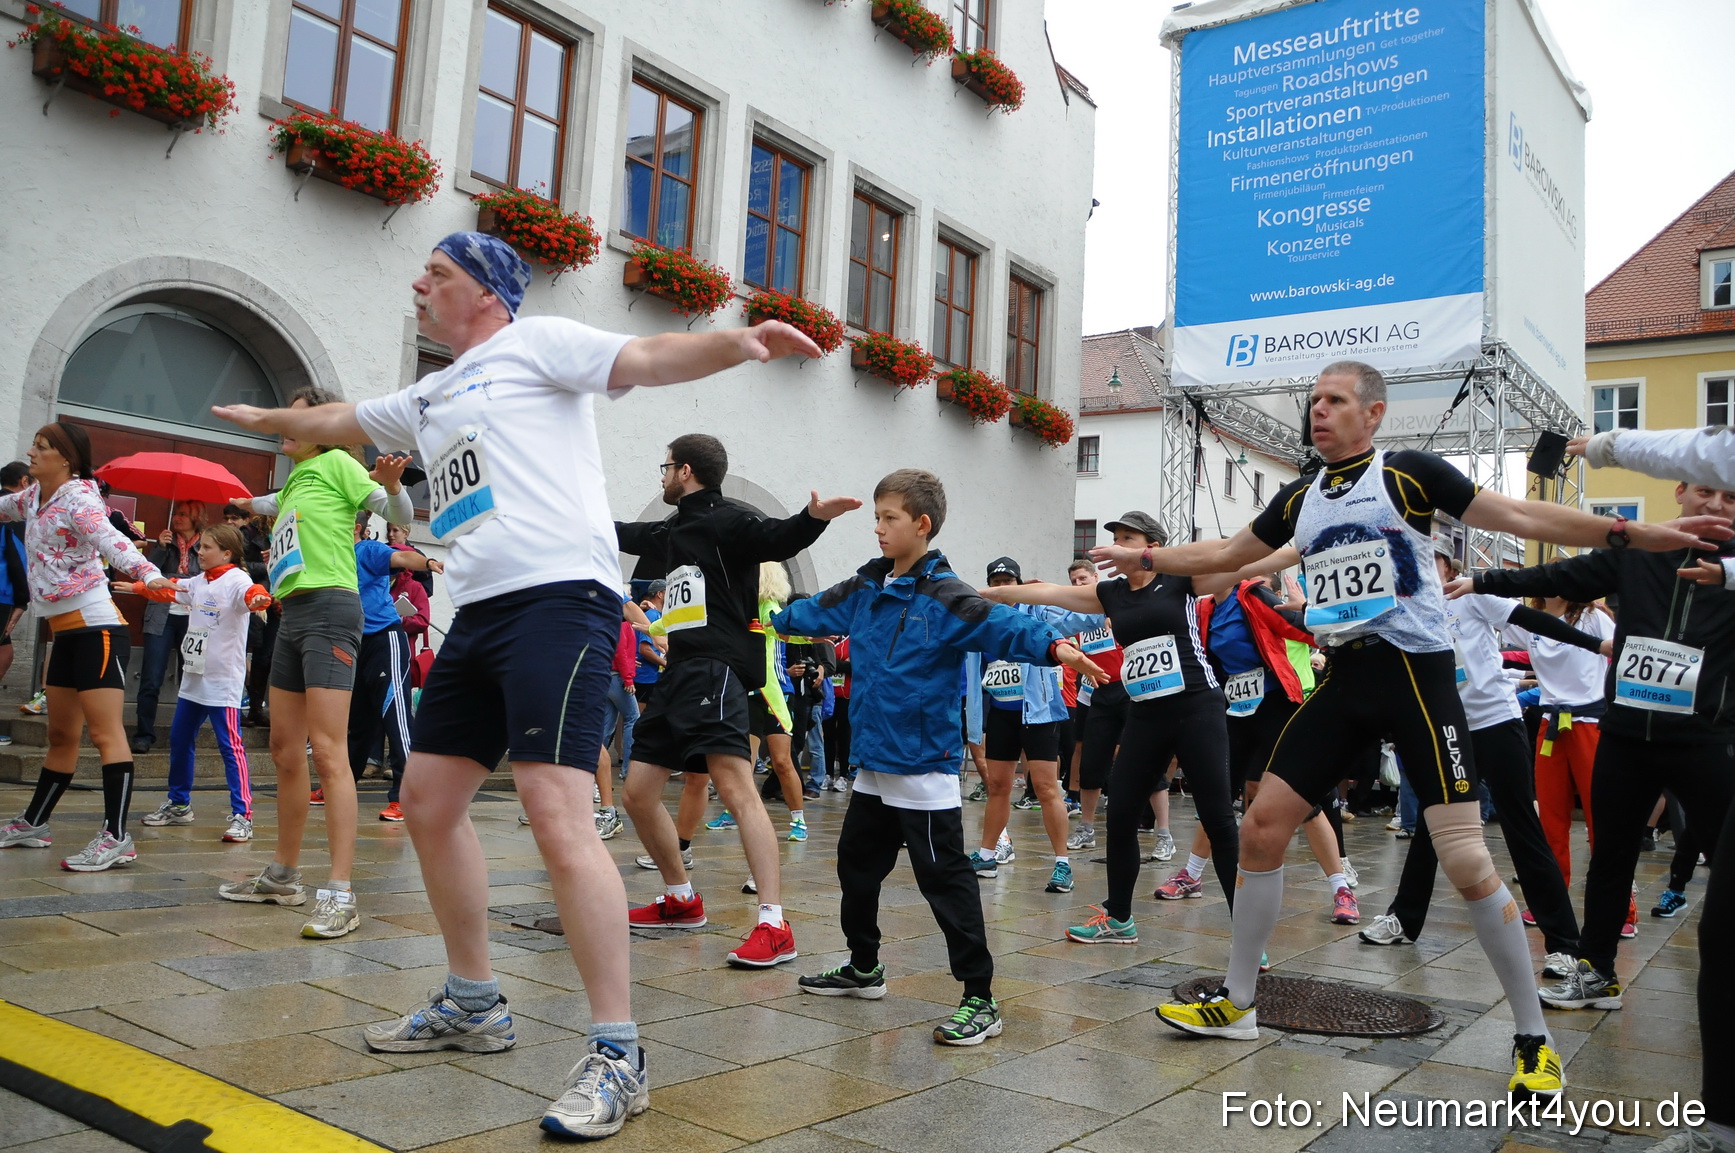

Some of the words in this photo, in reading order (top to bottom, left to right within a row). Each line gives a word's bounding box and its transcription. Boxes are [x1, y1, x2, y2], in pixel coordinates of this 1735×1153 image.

[1233, 7, 1420, 66] Messeauftritte
[1208, 40, 1376, 87] Hauptversammlungen
[1379, 37, 1398, 50] Get
[1400, 26, 1446, 47] together
[1234, 82, 1279, 99] Tagungen
[1282, 53, 1399, 92] Roadshows
[1226, 68, 1428, 124] Sportveranstaltungen
[1207, 105, 1361, 148] Installationen
[1365, 91, 1450, 116] TV-Produktionen
[1222, 125, 1373, 162] Kulturveranstaltungen
[1246, 152, 1310, 171] Fashionshows
[1315, 130, 1428, 159] Produktpräsentationen
[1231, 149, 1413, 193] Firmeneröffnungen
[1253, 181, 1326, 200] Firmenjubiläum
[1322, 183, 1385, 200] Firmenfeiern
[1524, 141, 1565, 222] BAROWSKI
[1566, 208, 1577, 239] AG
[1257, 196, 1372, 228] Kongresse
[1315, 217, 1364, 234] Musicals
[1267, 232, 1352, 256] Konzerte
[1287, 249, 1340, 263] Tourservice
[1250, 273, 1395, 302] www.barowski-ag.de
[1264, 325, 1379, 354] BAROWSKI
[1386, 321, 1420, 342] AG
[1264, 351, 1329, 363] Veranstaltungs-
[1331, 348, 1348, 357] und
[1349, 342, 1419, 355] Mediensysteme
[433, 449, 480, 512] 3180
[1345, 496, 1377, 507] DIADORA
[1306, 561, 1329, 573] PARTL
[1330, 551, 1371, 565] Neumarkt
[1313, 562, 1385, 605] 2132
[1338, 605, 1359, 620] ralf
[1136, 642, 1165, 654] Neumarkt
[1625, 642, 1646, 651] PARTL
[1646, 645, 1687, 660] Neumarkt
[985, 668, 1020, 686] 2208
[1126, 650, 1174, 680] 2229
[1623, 653, 1691, 686] 2677
[1140, 680, 1162, 692] Birgit
[1228, 679, 1259, 700] 2441
[1629, 688, 1672, 702] andreas
